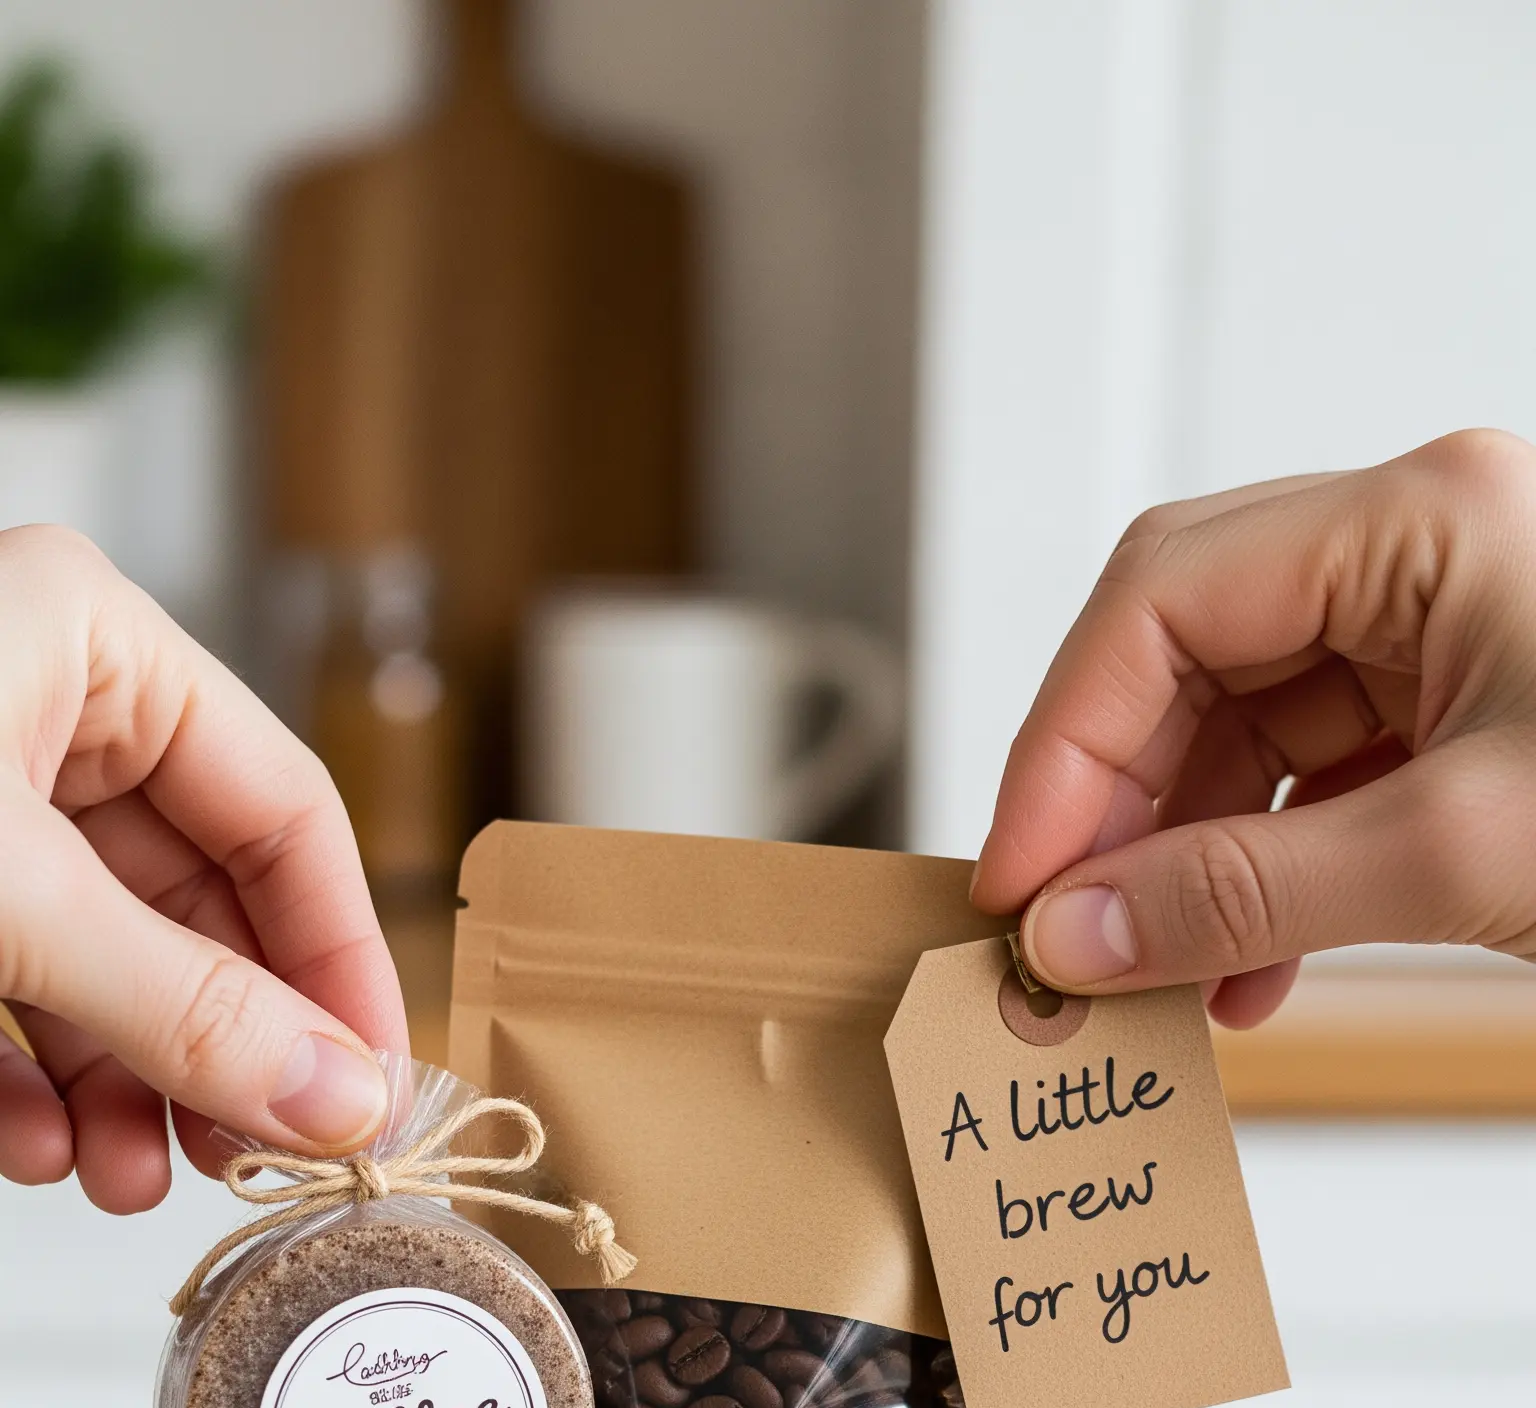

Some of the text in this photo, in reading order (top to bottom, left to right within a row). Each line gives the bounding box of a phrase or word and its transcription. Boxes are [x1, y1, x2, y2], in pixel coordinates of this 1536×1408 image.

[941, 1057, 1174, 1161] A little
[996, 1161, 1157, 1239] brew
[989, 1253, 1210, 1352] for you
